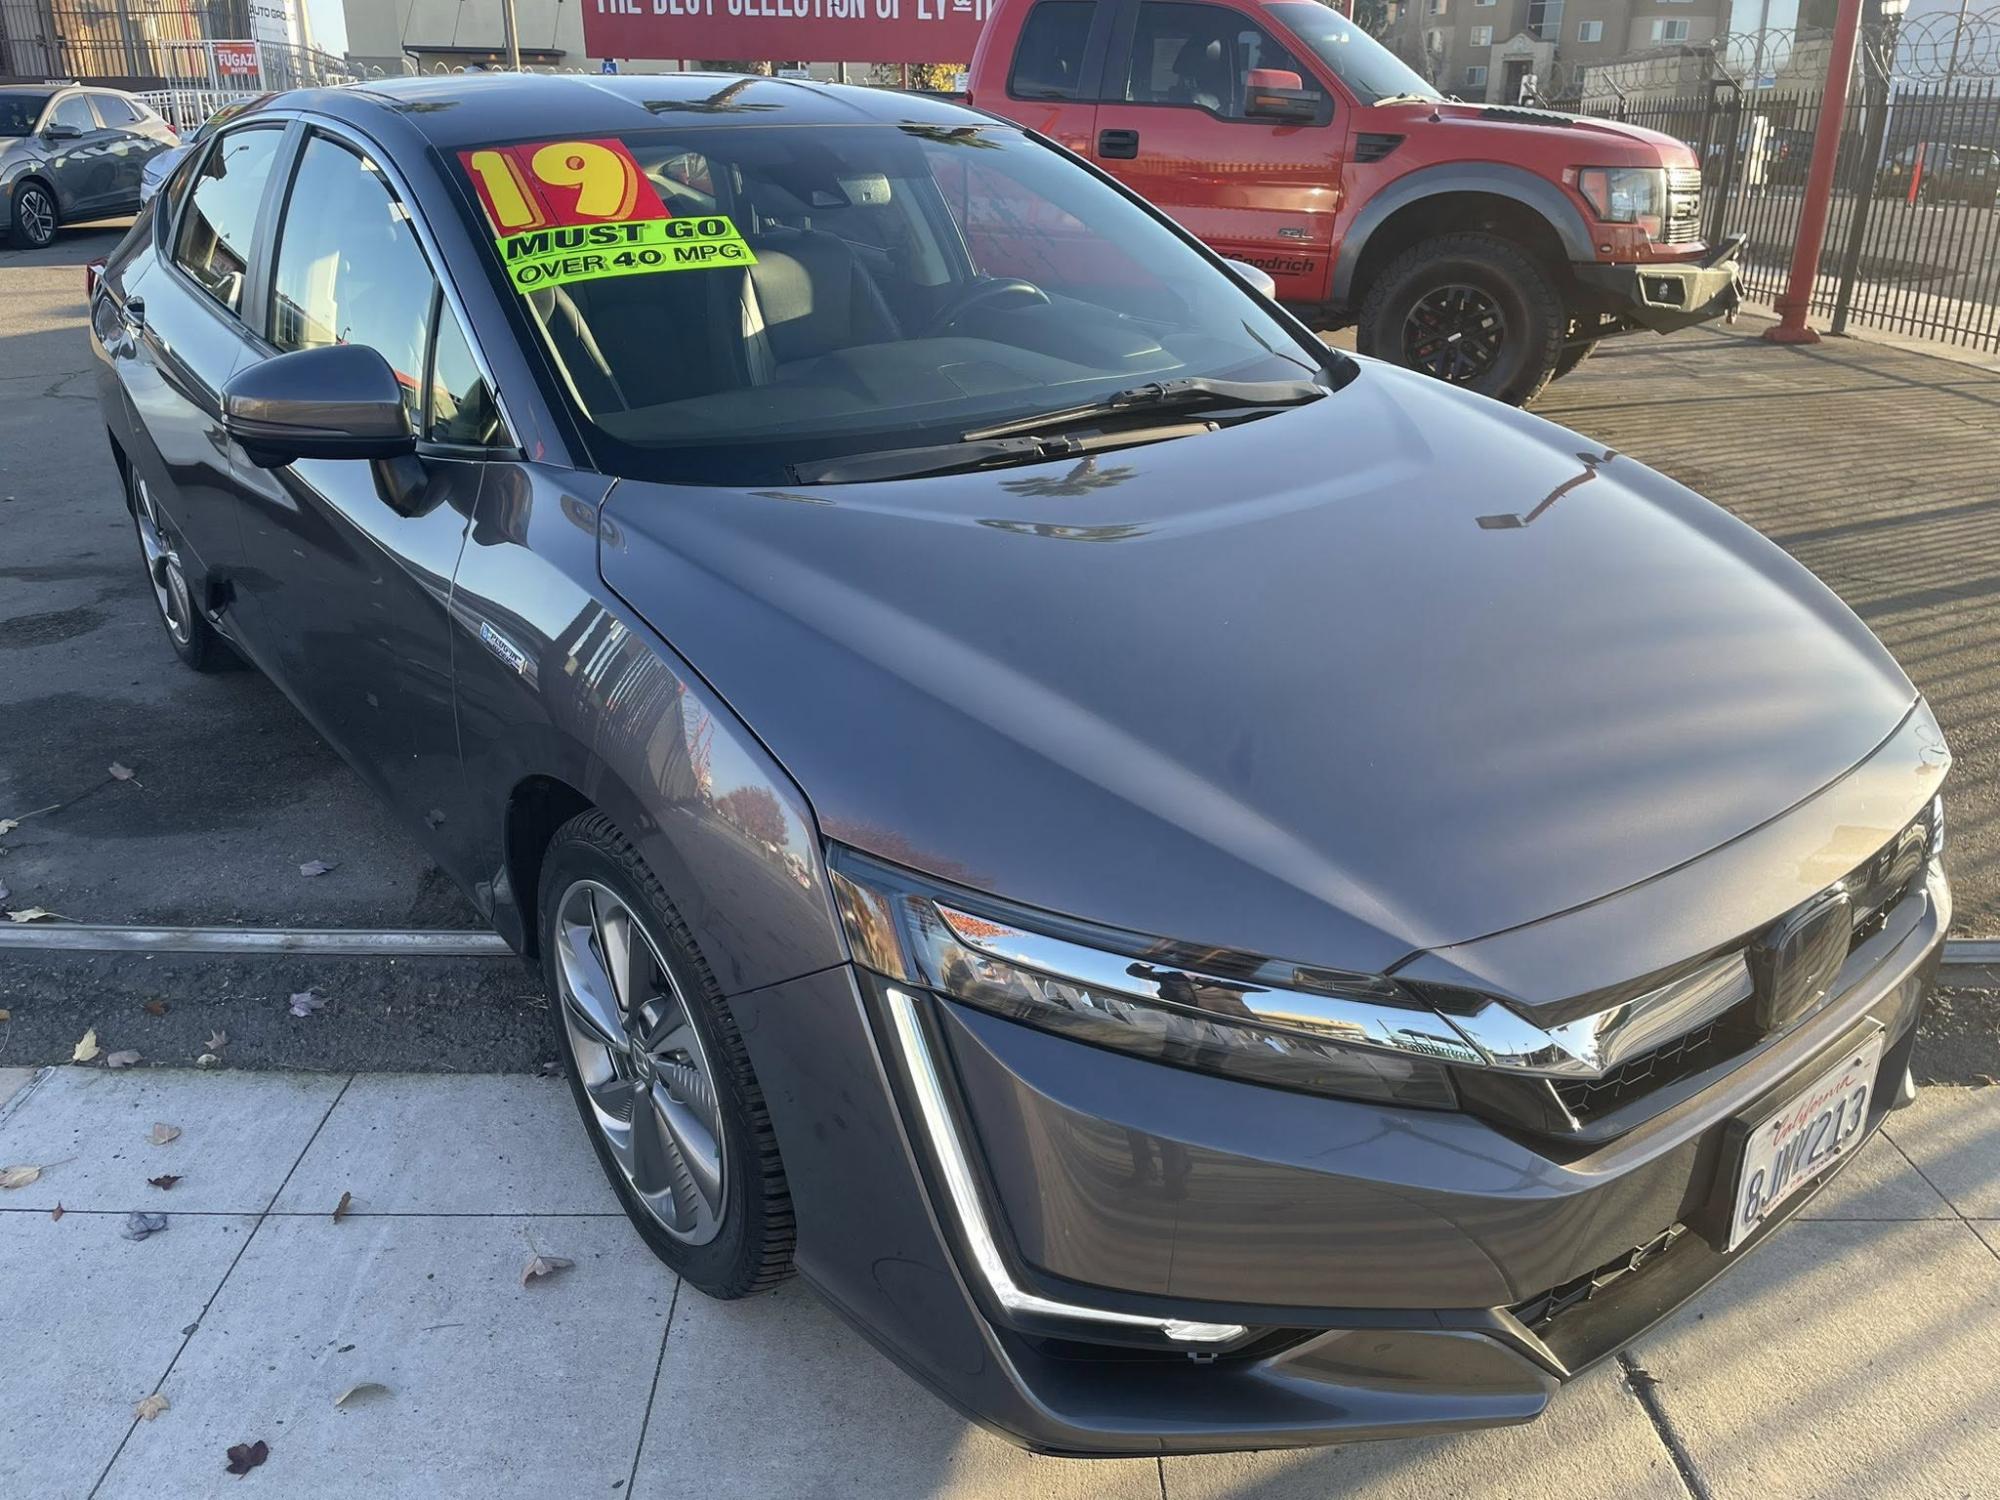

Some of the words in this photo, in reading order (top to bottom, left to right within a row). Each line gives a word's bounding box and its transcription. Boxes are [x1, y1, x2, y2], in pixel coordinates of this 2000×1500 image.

[218, 53, 257, 67] FUGAZI
[471, 142, 638, 229] 19
[507, 222, 647, 260] MUST
[665, 218, 729, 239] GO
[516, 254, 607, 285] OVER
[613, 249, 666, 267] 40
[674, 243, 745, 264] MPG
